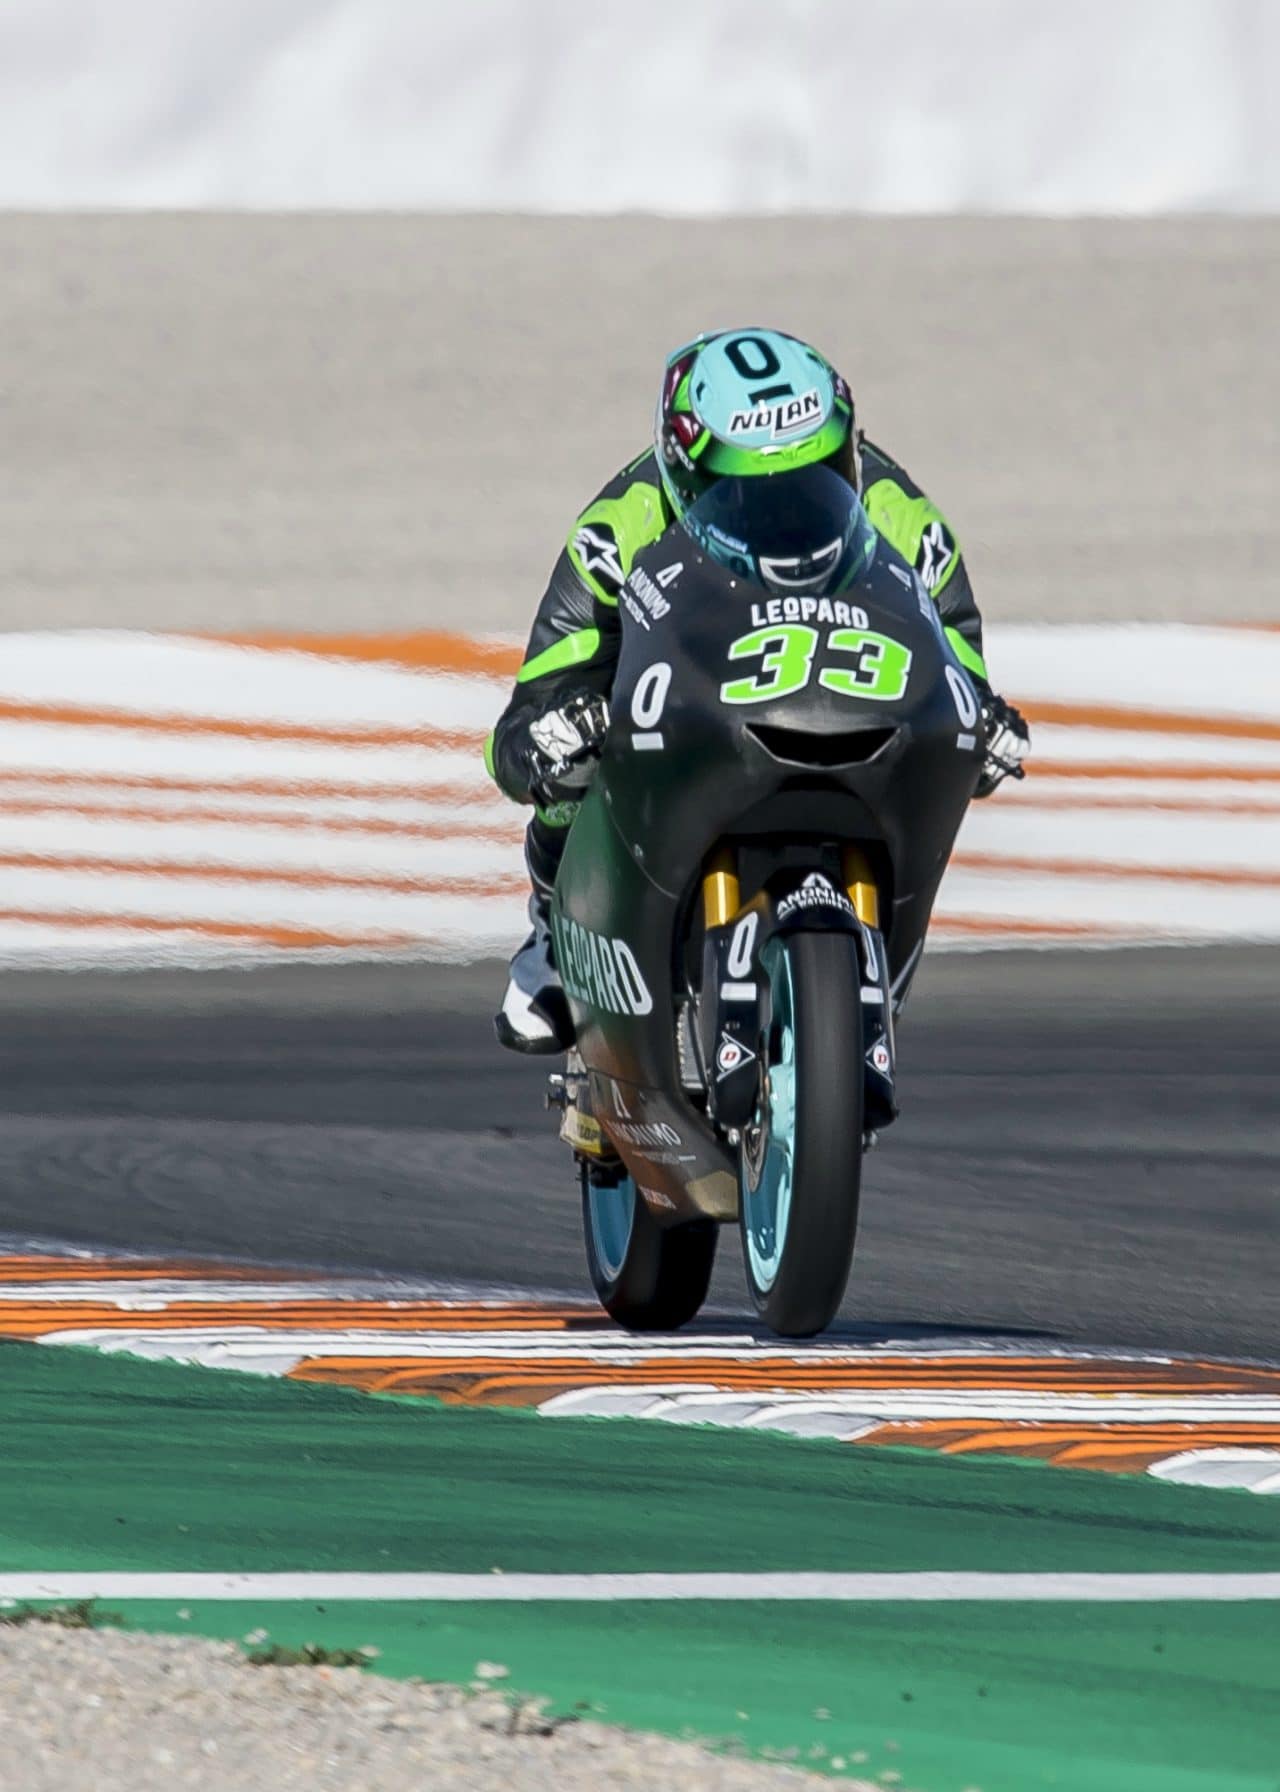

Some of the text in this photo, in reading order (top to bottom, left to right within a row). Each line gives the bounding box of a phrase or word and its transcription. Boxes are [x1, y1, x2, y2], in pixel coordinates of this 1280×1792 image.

[730, 391, 820, 432] NOLAN
[751, 597, 870, 630] LEOPARD
[720, 623, 913, 704] 33
[777, 887, 857, 916] ANONIM
[553, 913, 653, 1015] LEOPARD
